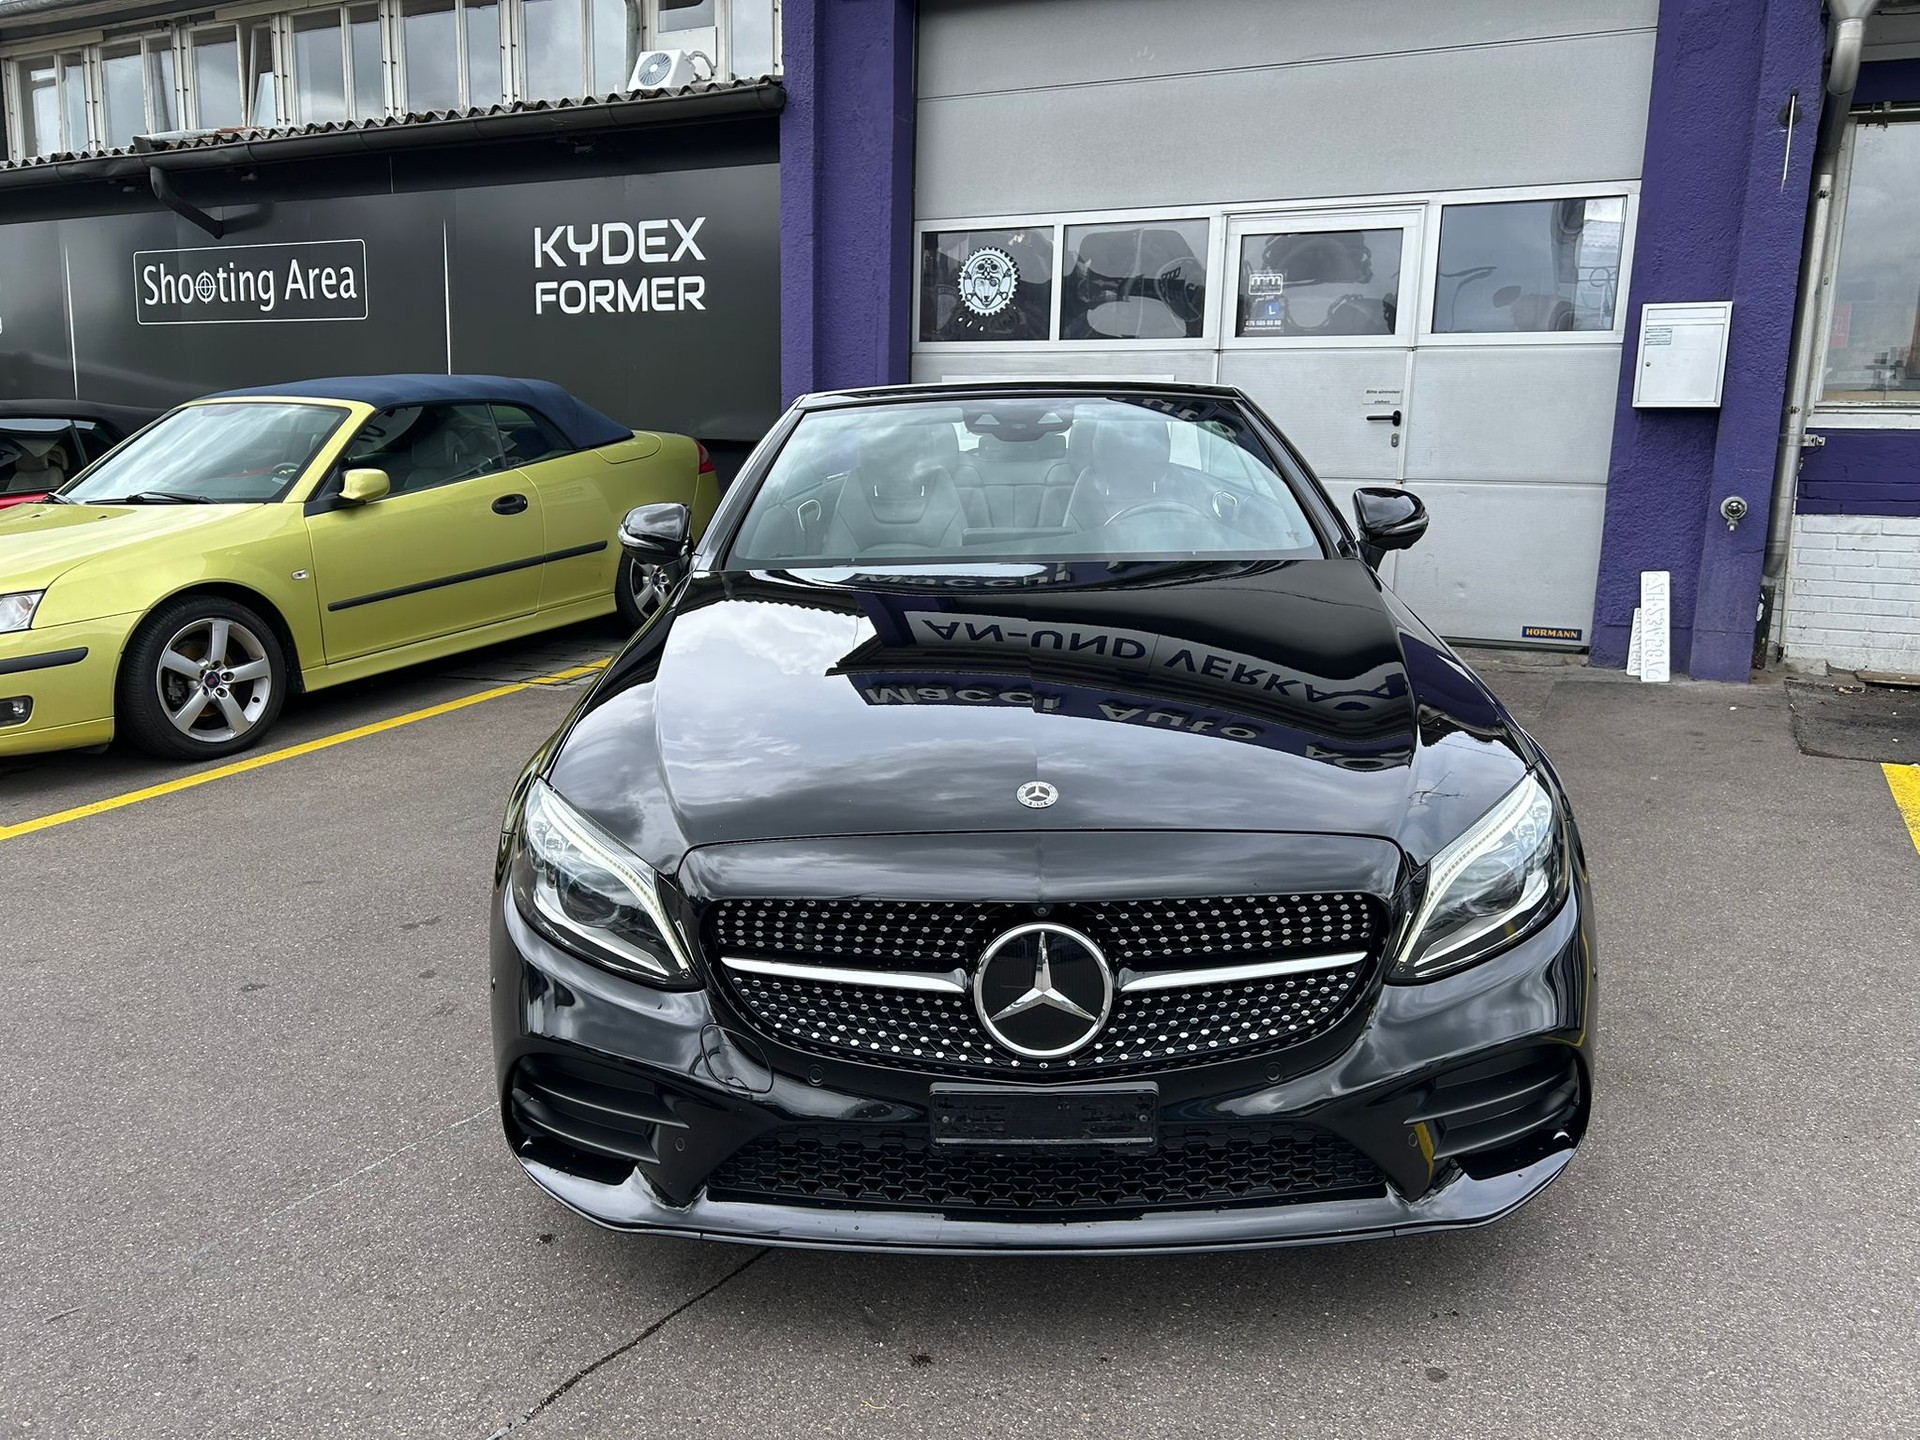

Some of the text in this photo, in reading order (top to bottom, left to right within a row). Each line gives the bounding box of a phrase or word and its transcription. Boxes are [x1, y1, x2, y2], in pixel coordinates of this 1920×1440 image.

[534, 217, 707, 268] KYDEX
[284, 259, 358, 300] Area
[535, 276, 706, 315] FORMER
